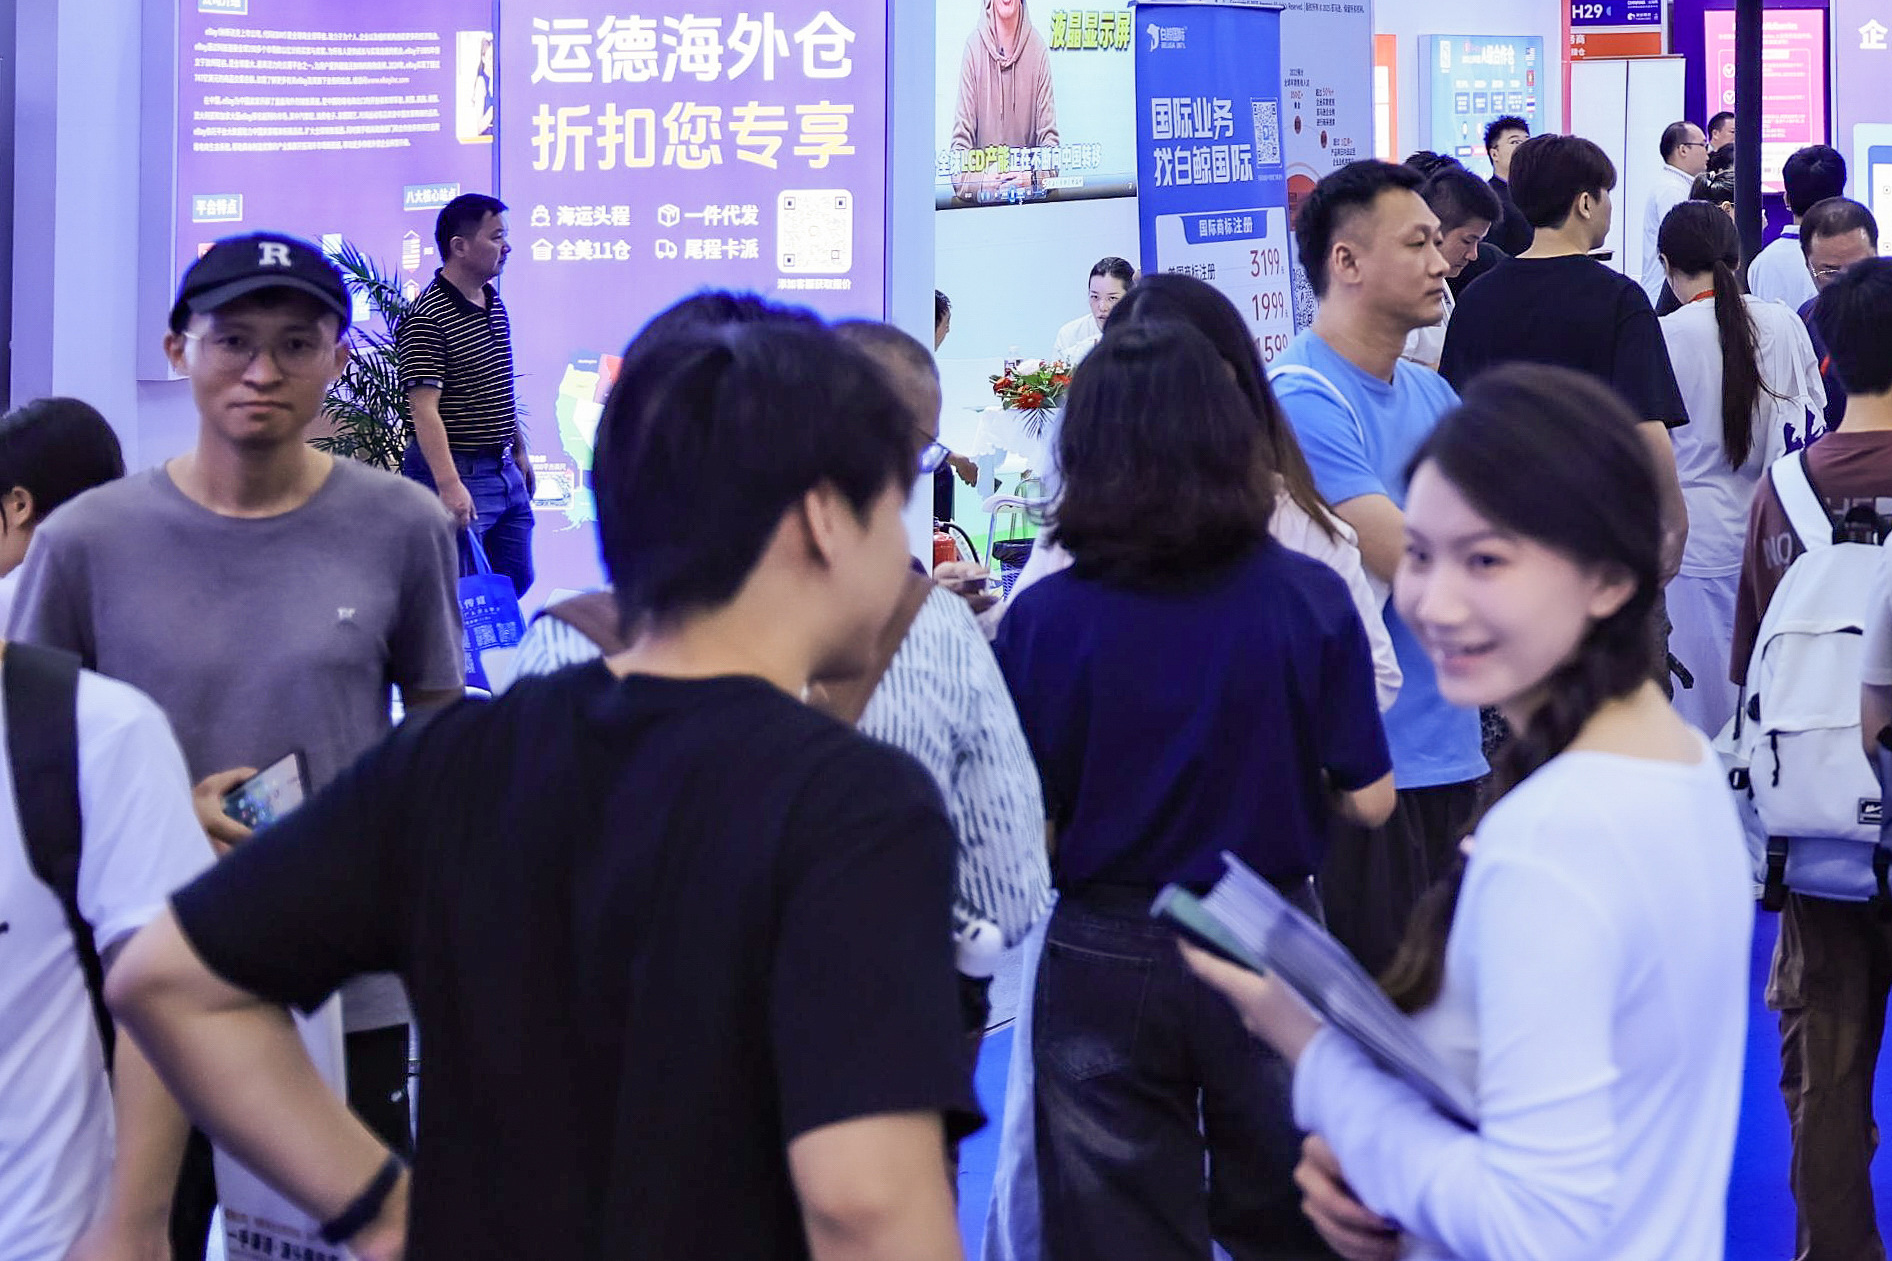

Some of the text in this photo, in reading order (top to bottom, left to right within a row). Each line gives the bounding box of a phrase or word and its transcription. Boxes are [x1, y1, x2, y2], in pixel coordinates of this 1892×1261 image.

[1572, 4, 1603, 19] H29
[1050, 9, 1132, 51] 液晶显示屏
[531, 10, 856, 85] 运德海外仓
[1151, 97, 1233, 140] 国际业务
[531, 100, 856, 172] 折扣您专享
[936, 143, 1103, 176] 全球LCD产能正在不断向中国转移
[1153, 143, 1254, 187] 找白鲸国际
[556, 204, 759, 227] 海运头程 一件代发
[1199, 216, 1253, 237] 国际商标注册
[258, 242, 291, 266] R
[556, 238, 759, 261] 全美11仓 尾程卡派
[1250, 248, 1280, 278] 3199
[1252, 291, 1284, 322] 1999
